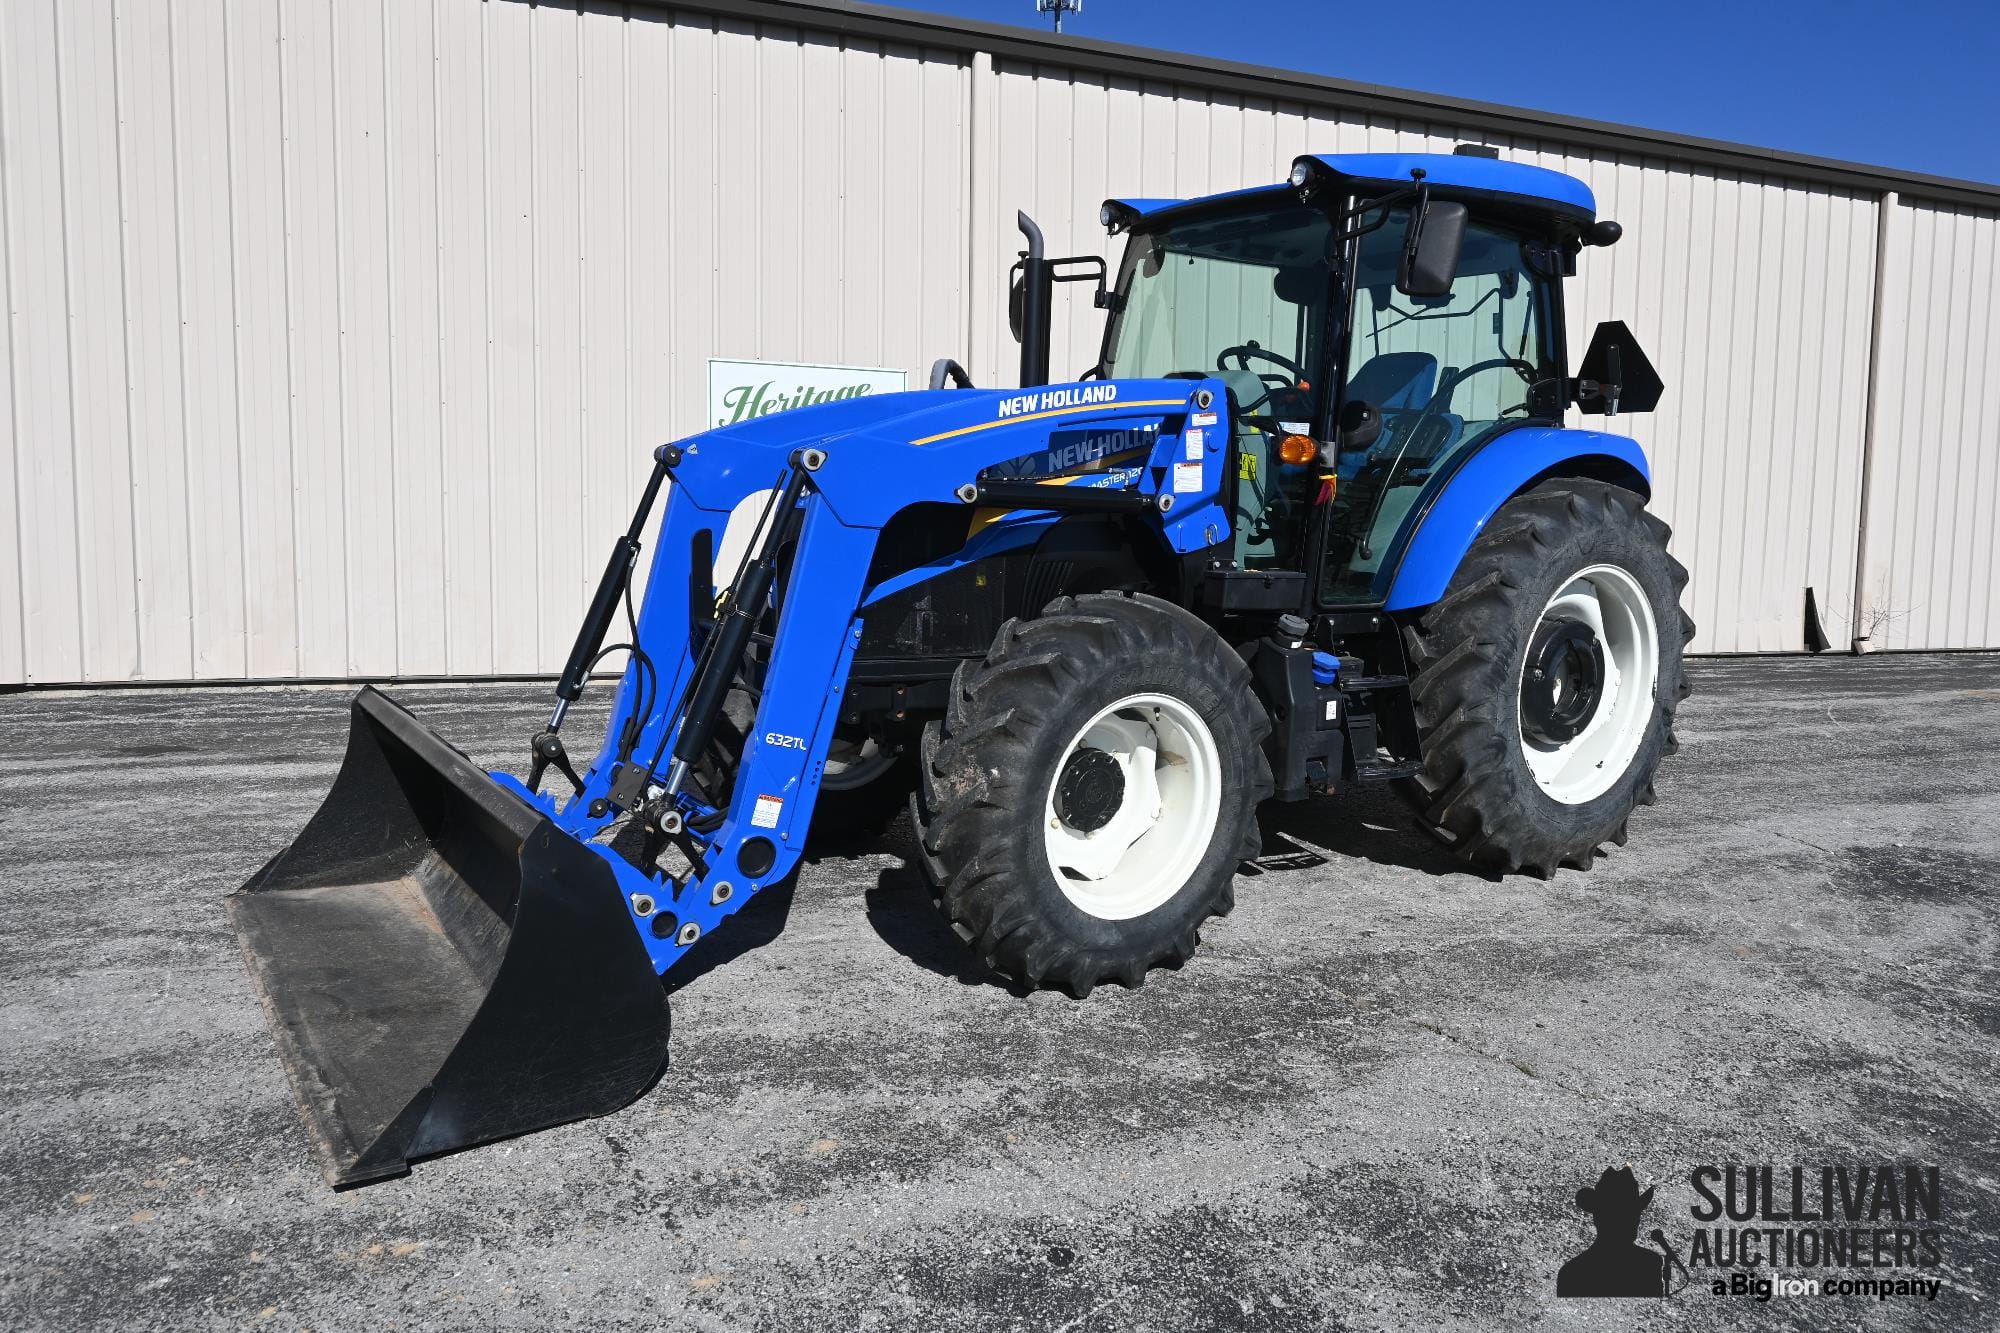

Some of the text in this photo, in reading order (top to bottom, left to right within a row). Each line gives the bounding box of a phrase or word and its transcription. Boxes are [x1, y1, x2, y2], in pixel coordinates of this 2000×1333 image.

[998, 384, 1117, 418] NEW HOLLAND
[1048, 438, 1096, 473] NEW
[765, 732, 807, 751] 632TL
